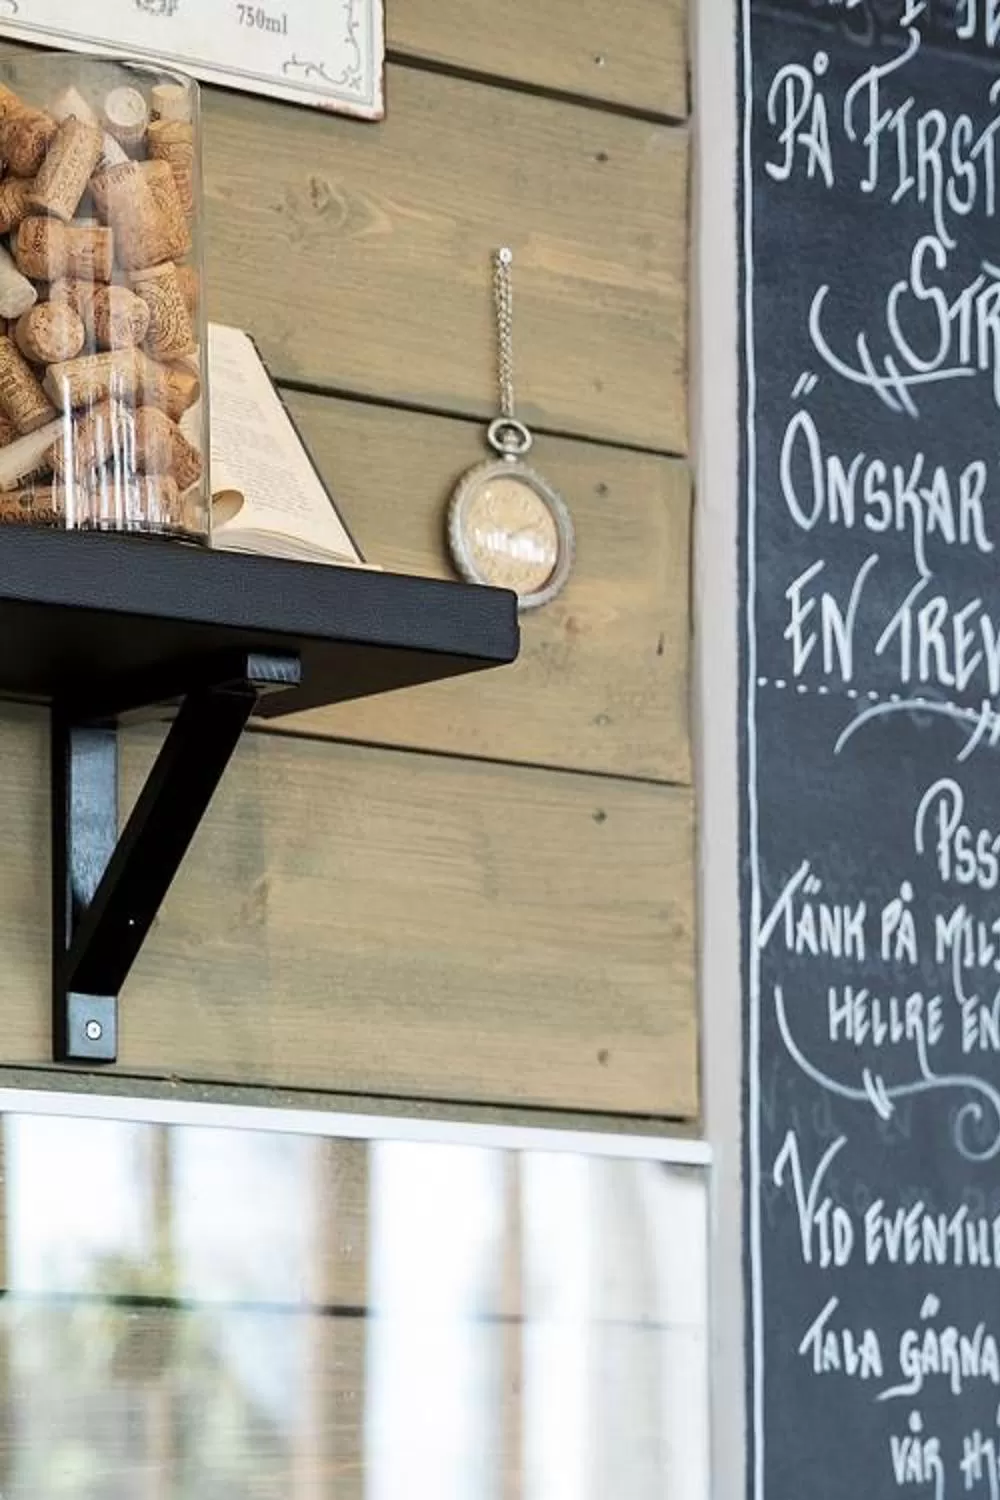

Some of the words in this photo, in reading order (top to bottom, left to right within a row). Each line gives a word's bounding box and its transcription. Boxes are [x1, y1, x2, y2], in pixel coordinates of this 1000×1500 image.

[236, 4, 288, 35] 750ml
[765, 51, 833, 188] PÅ
[780, 373, 994, 553] ÖNSKAR
[784, 553, 878, 682] EN
[759, 860, 866, 960] TÄNK
[881, 880, 918, 965] PÅ
[828, 984, 945, 1060] HELLRE
[773, 1130, 856, 1268] VID
[800, 1296, 883, 1379] TALA
[885, 1292, 1000, 1398] GÄRNA
